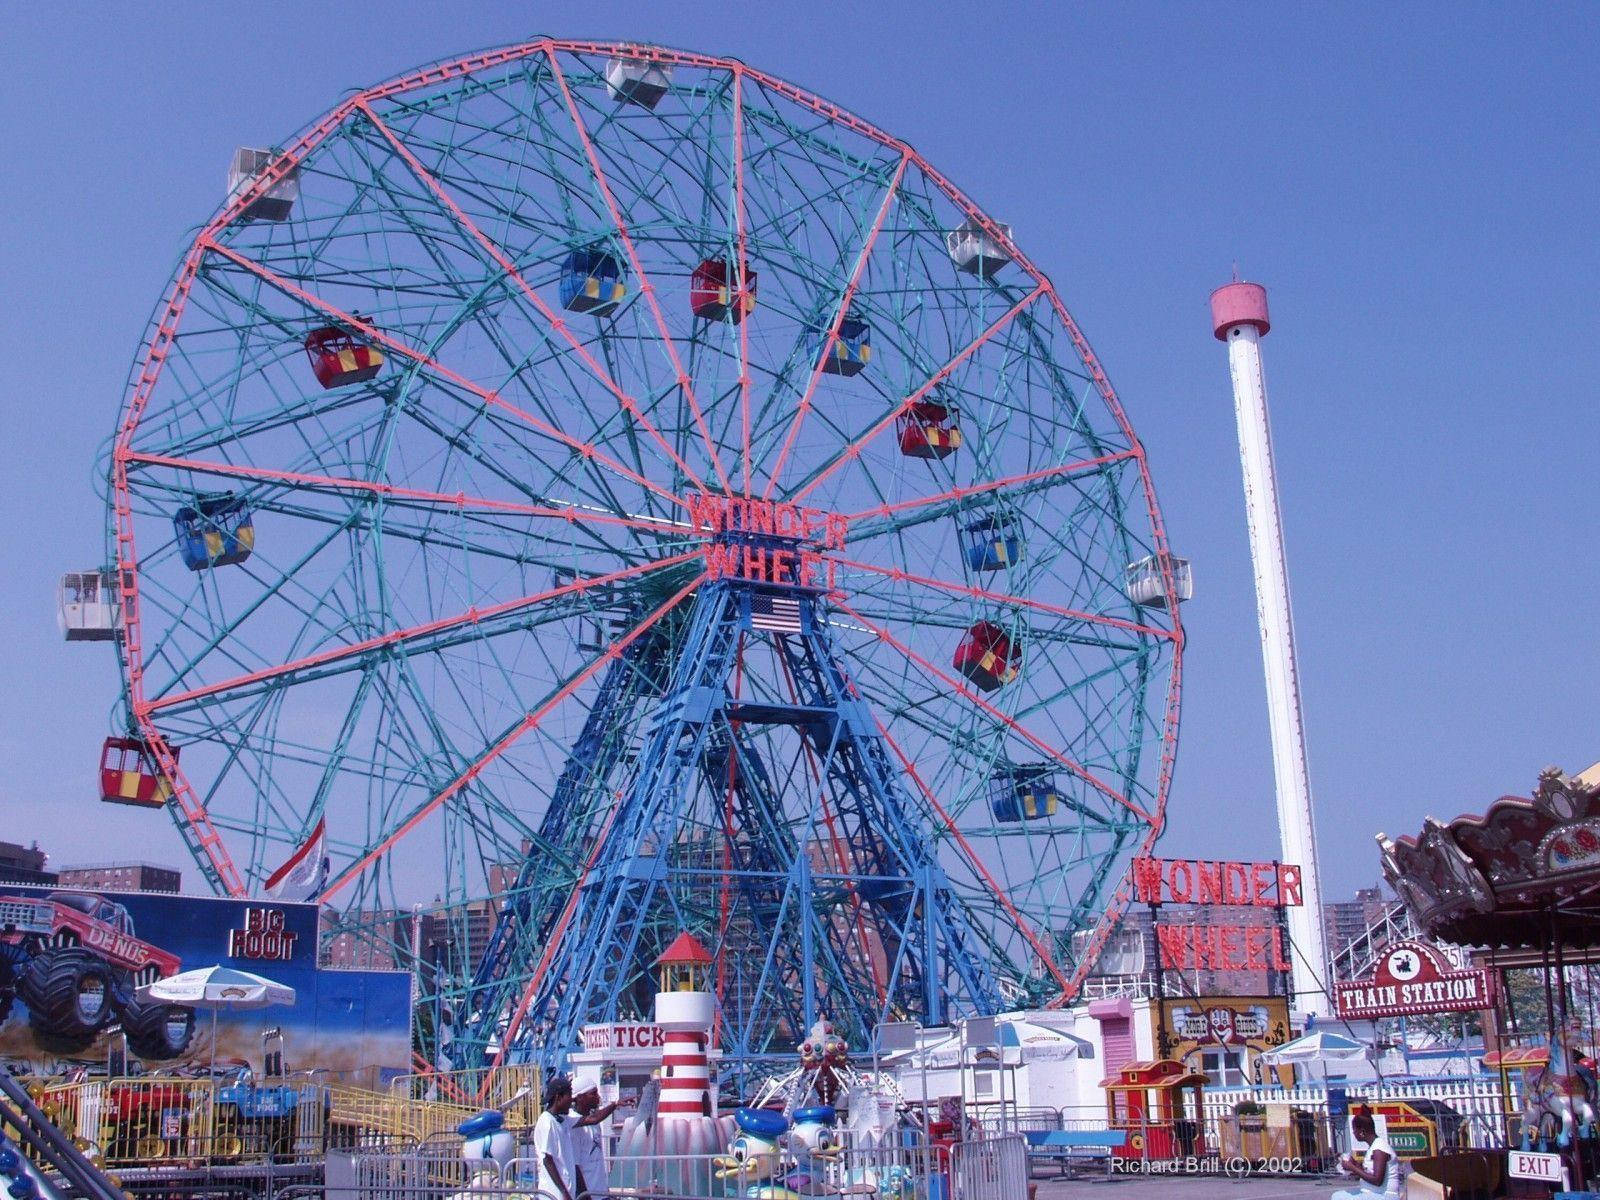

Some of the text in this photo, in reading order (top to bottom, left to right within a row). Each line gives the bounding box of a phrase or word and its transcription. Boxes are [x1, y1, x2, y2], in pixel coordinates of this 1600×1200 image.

[688, 494, 848, 551] WONDER
[704, 543, 848, 600] WHEEL
[1133, 858, 1302, 906] WONDER
[245, 908, 285, 932] BIG
[228, 929, 298, 960] FOOT
[1158, 925, 1292, 971] WHEEL
[1342, 978, 1477, 1010] TRAIN STATION
[586, 1029, 609, 1048] TICKETS
[1519, 1156, 1551, 1175] EXIT
